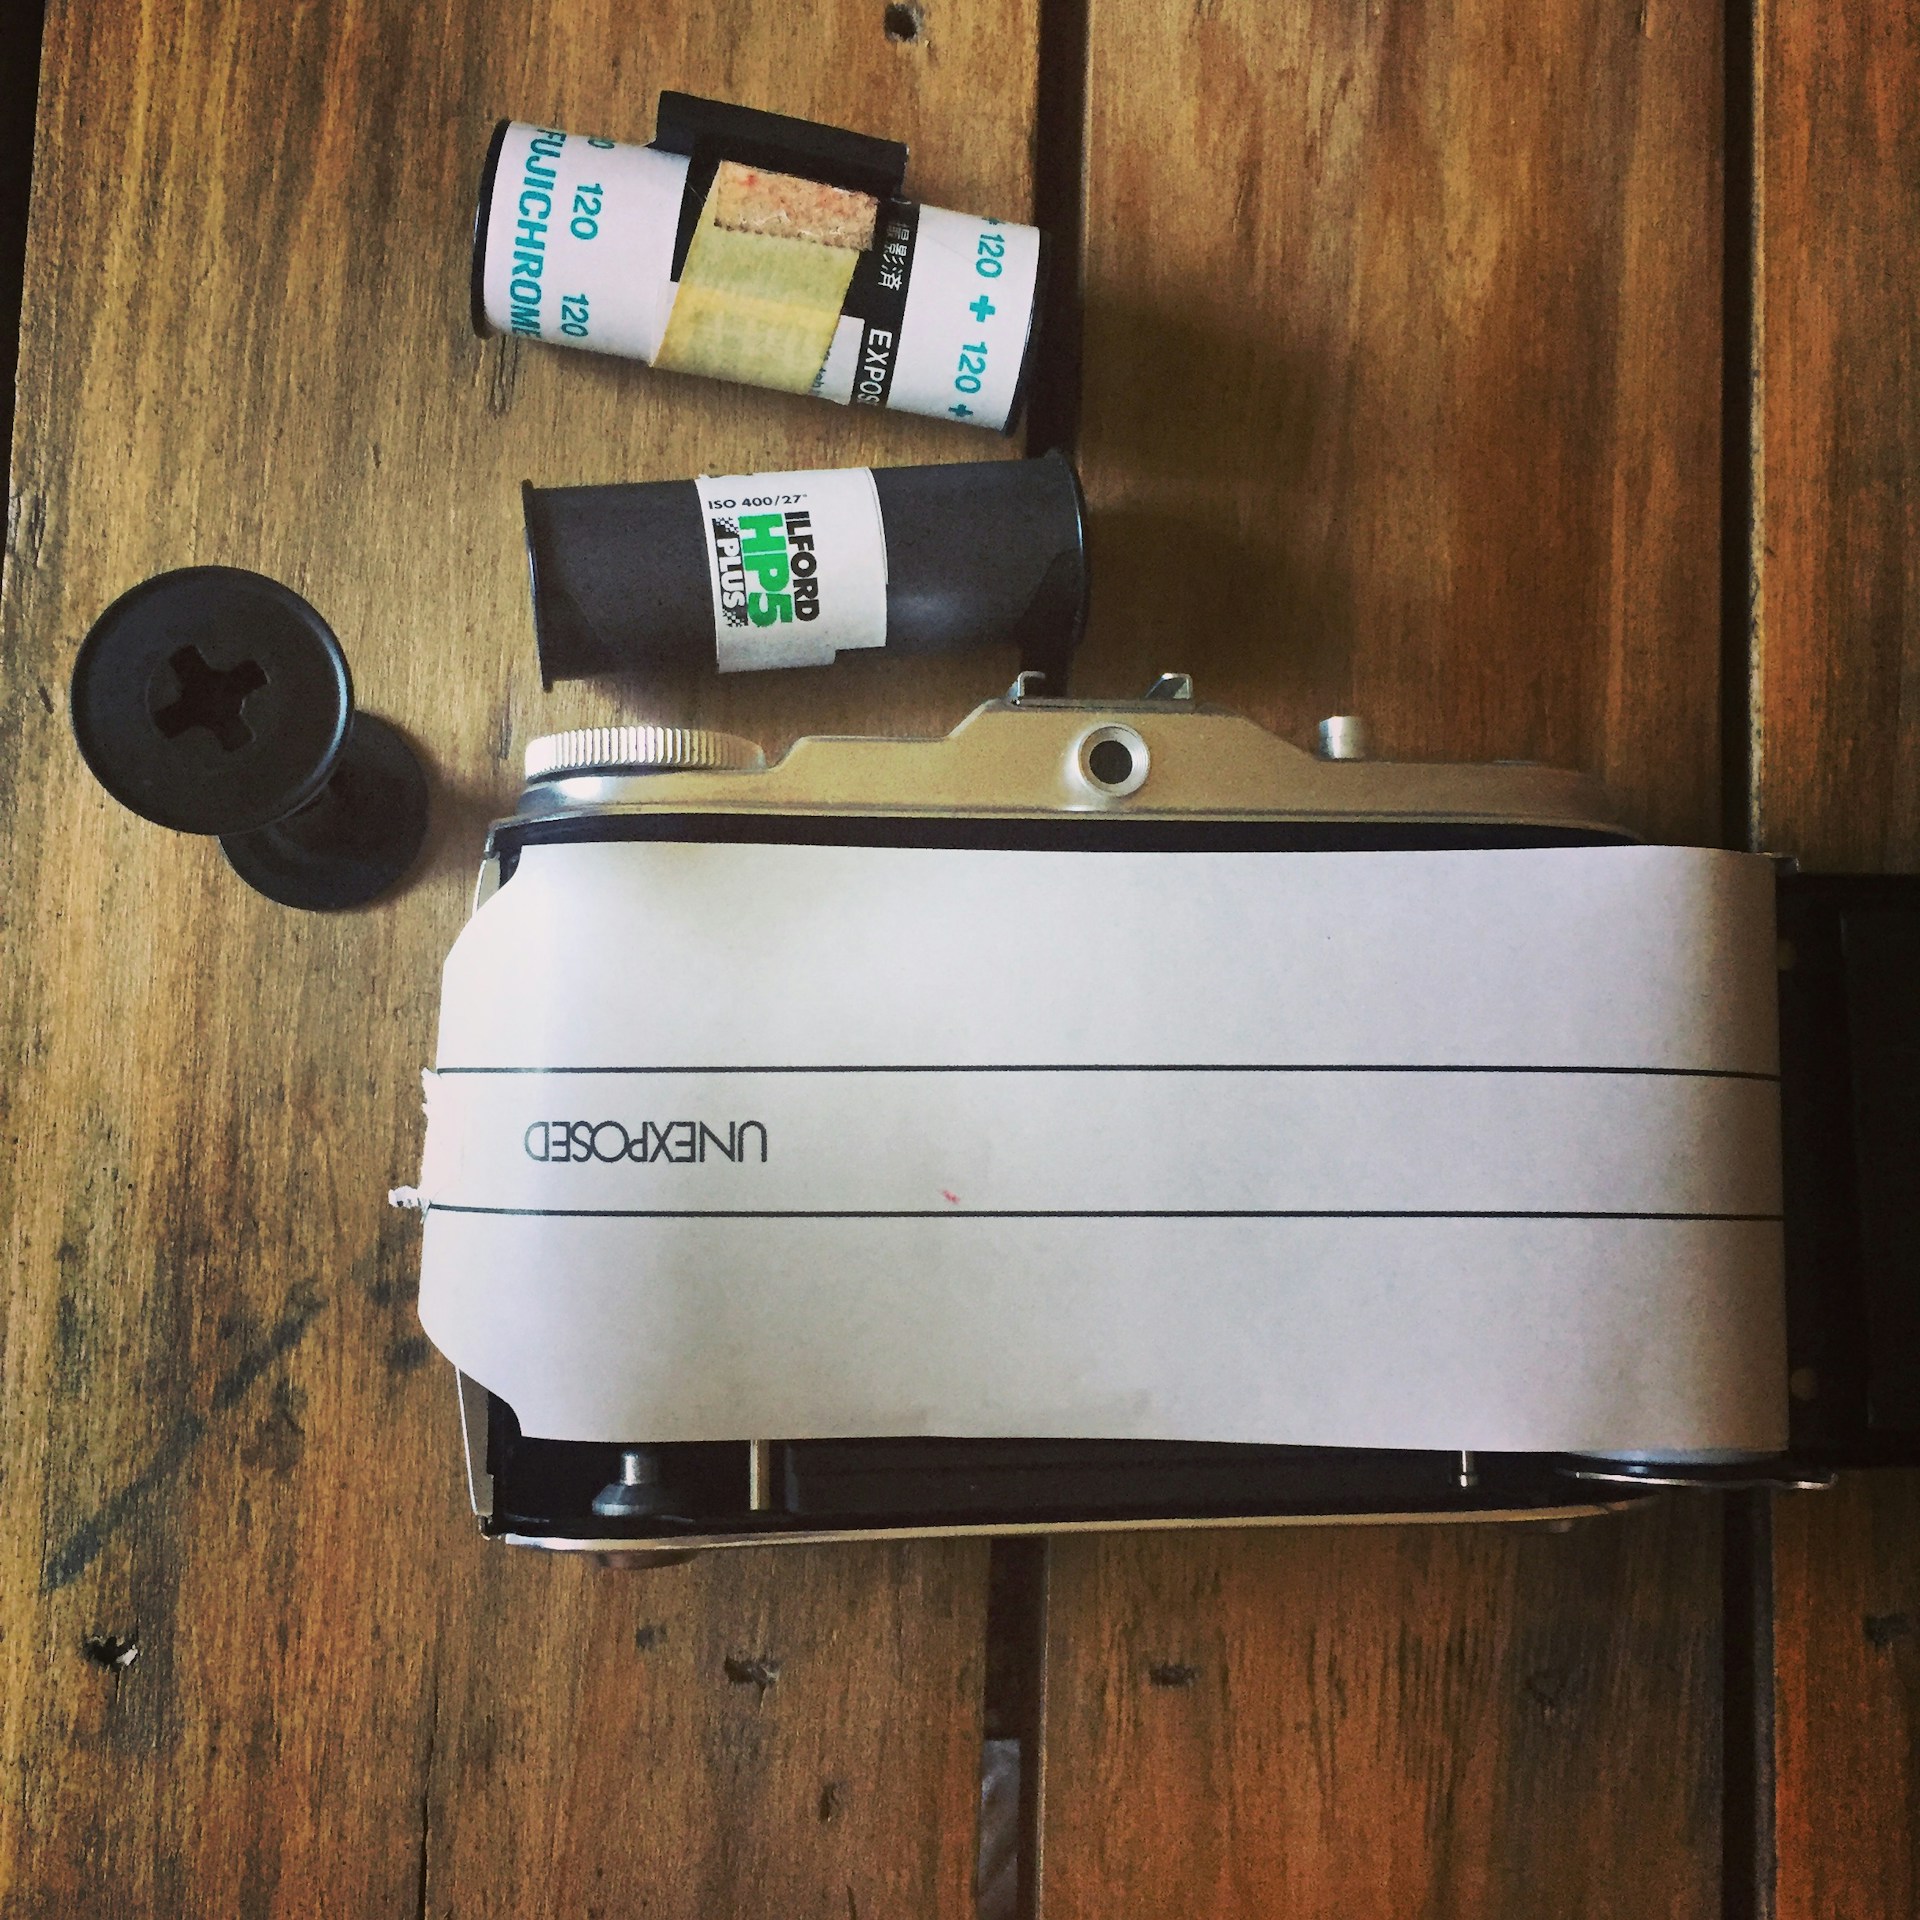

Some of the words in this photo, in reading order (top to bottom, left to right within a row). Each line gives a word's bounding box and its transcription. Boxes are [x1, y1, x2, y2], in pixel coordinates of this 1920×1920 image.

[570, 183, 604, 240] 120
[975, 233, 1005, 278] 120
[560, 293, 589, 338] 120
[955, 341, 988, 394] 120
[708, 499, 737, 510] ISO
[716, 537, 746, 609] PLUS
[737, 513, 793, 628] HP5
[784, 511, 820, 622] ILFORD
[524, 1120, 768, 1163] UNEXPOSED
